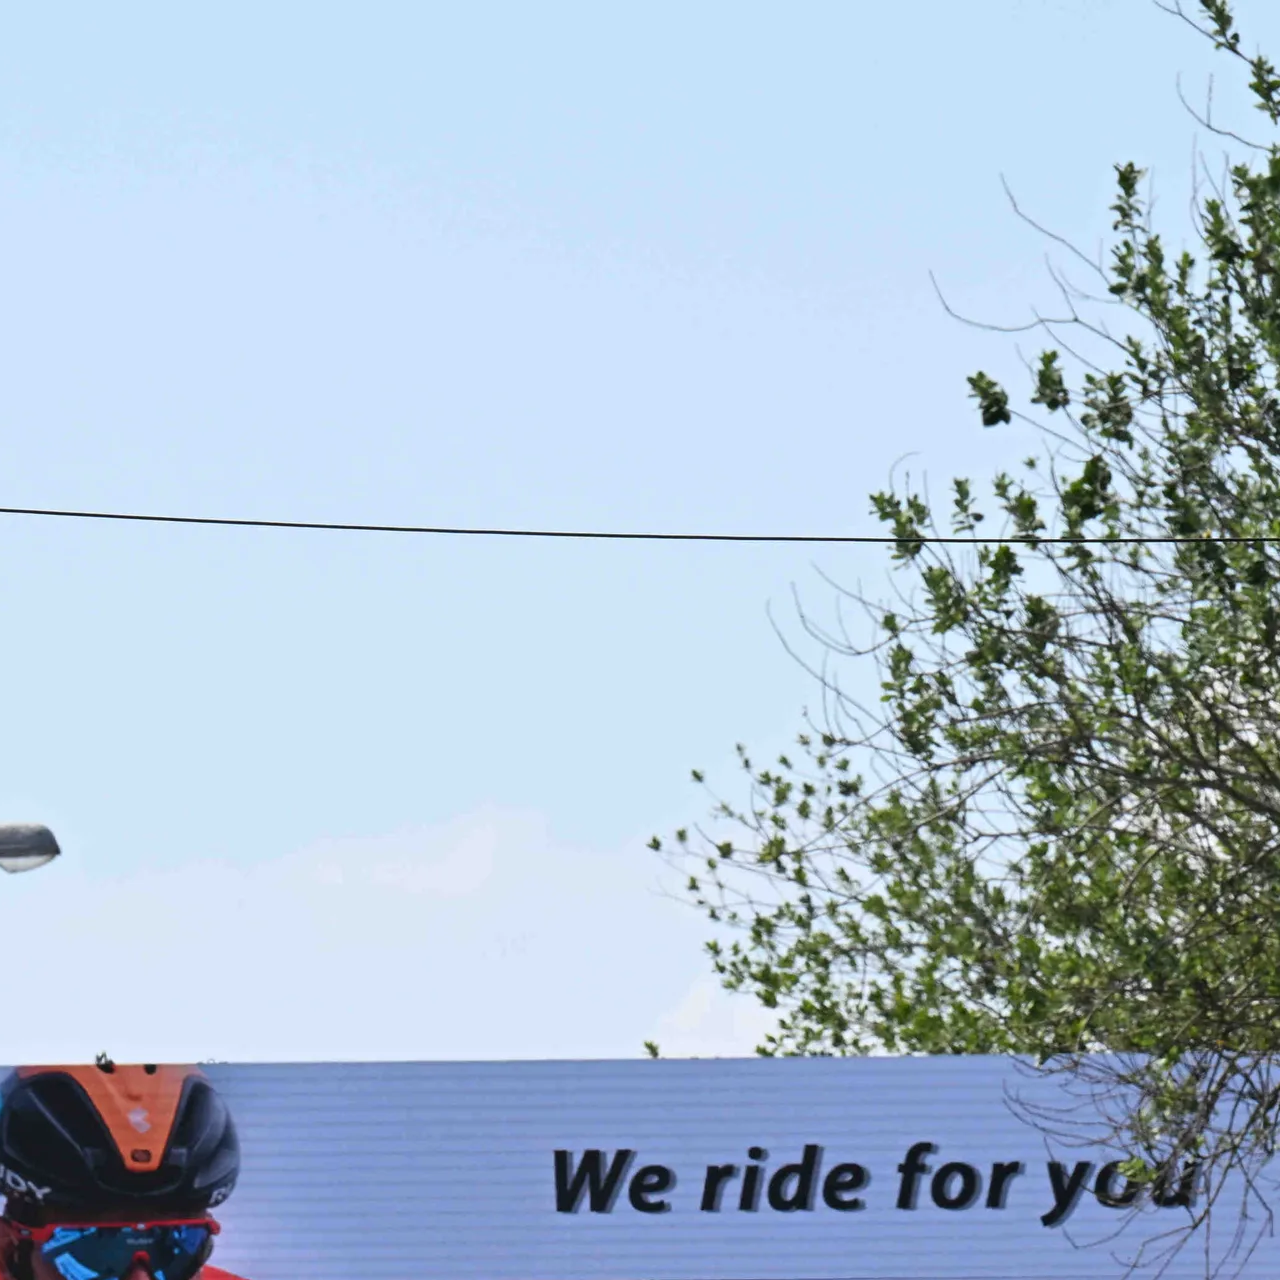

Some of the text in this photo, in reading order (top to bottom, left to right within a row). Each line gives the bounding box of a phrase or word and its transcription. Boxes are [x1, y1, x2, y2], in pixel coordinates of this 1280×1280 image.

[553, 1141, 1201, 1228] We ride for you
